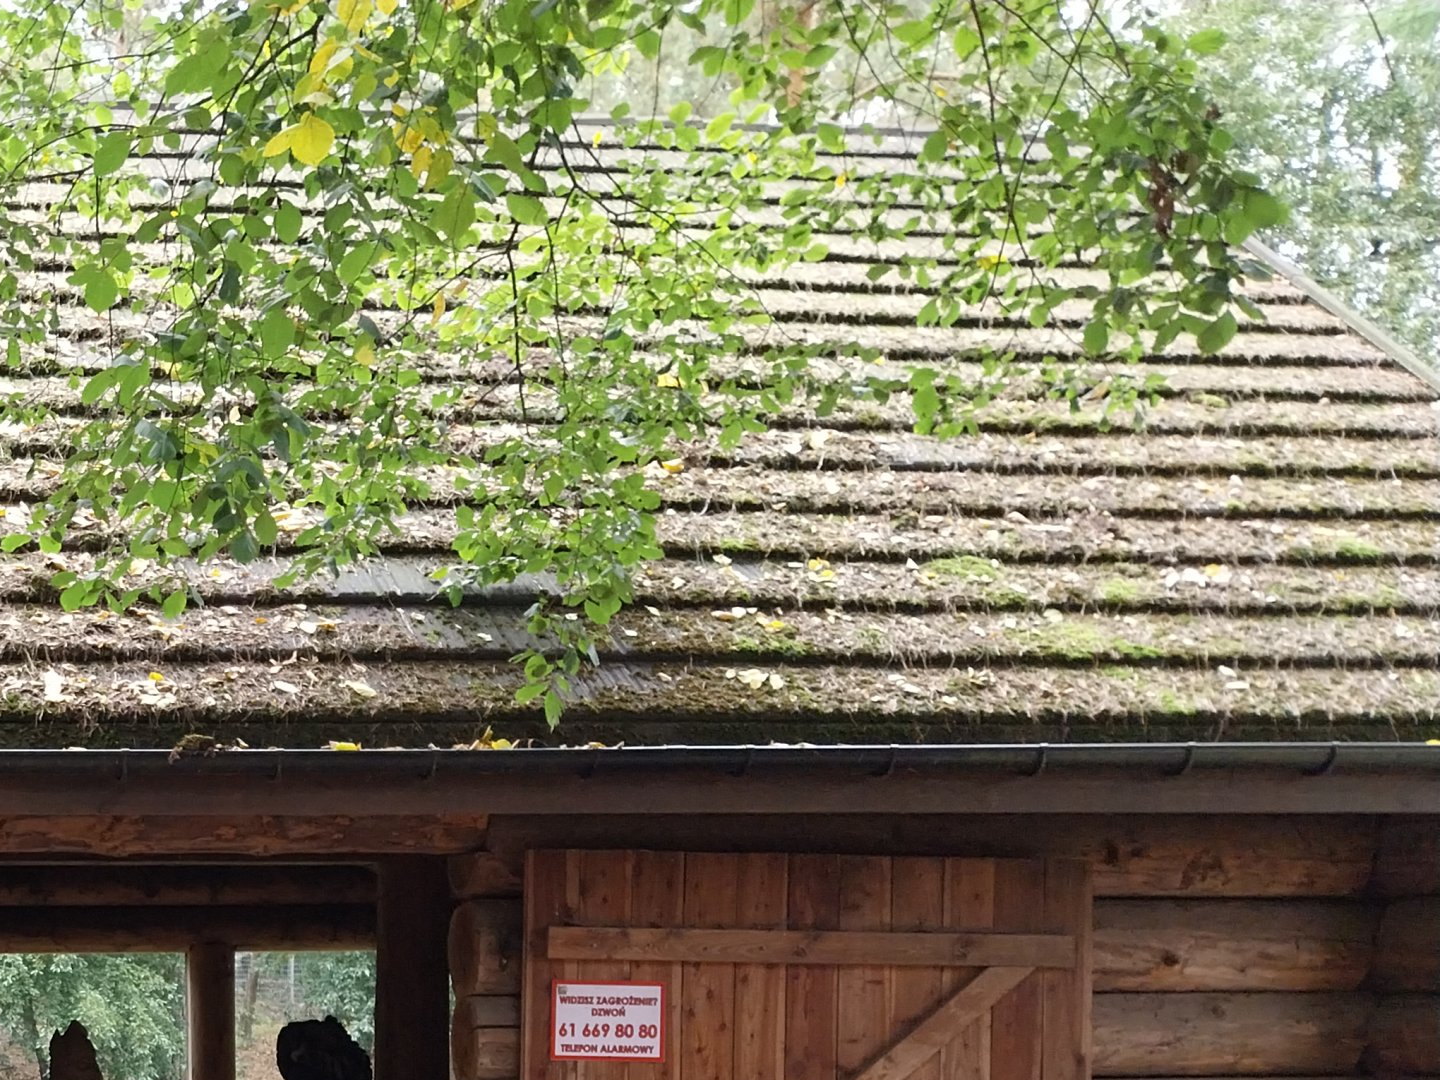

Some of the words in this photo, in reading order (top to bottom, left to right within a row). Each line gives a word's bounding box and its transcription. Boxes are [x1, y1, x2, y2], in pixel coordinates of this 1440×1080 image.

[559, 995, 594, 1005] WIDZISZ
[596, 995, 658, 1006] ZAGROŻENIE?
[591, 1006, 626, 1017] DZWOŃ
[559, 1023, 576, 1037] 61
[582, 1023, 610, 1037] 669
[615, 1023, 634, 1038] 80
[638, 1024, 658, 1038] 80
[560, 1043, 598, 1053] TELEFON
[600, 1044, 655, 1054] ALARMOWY
